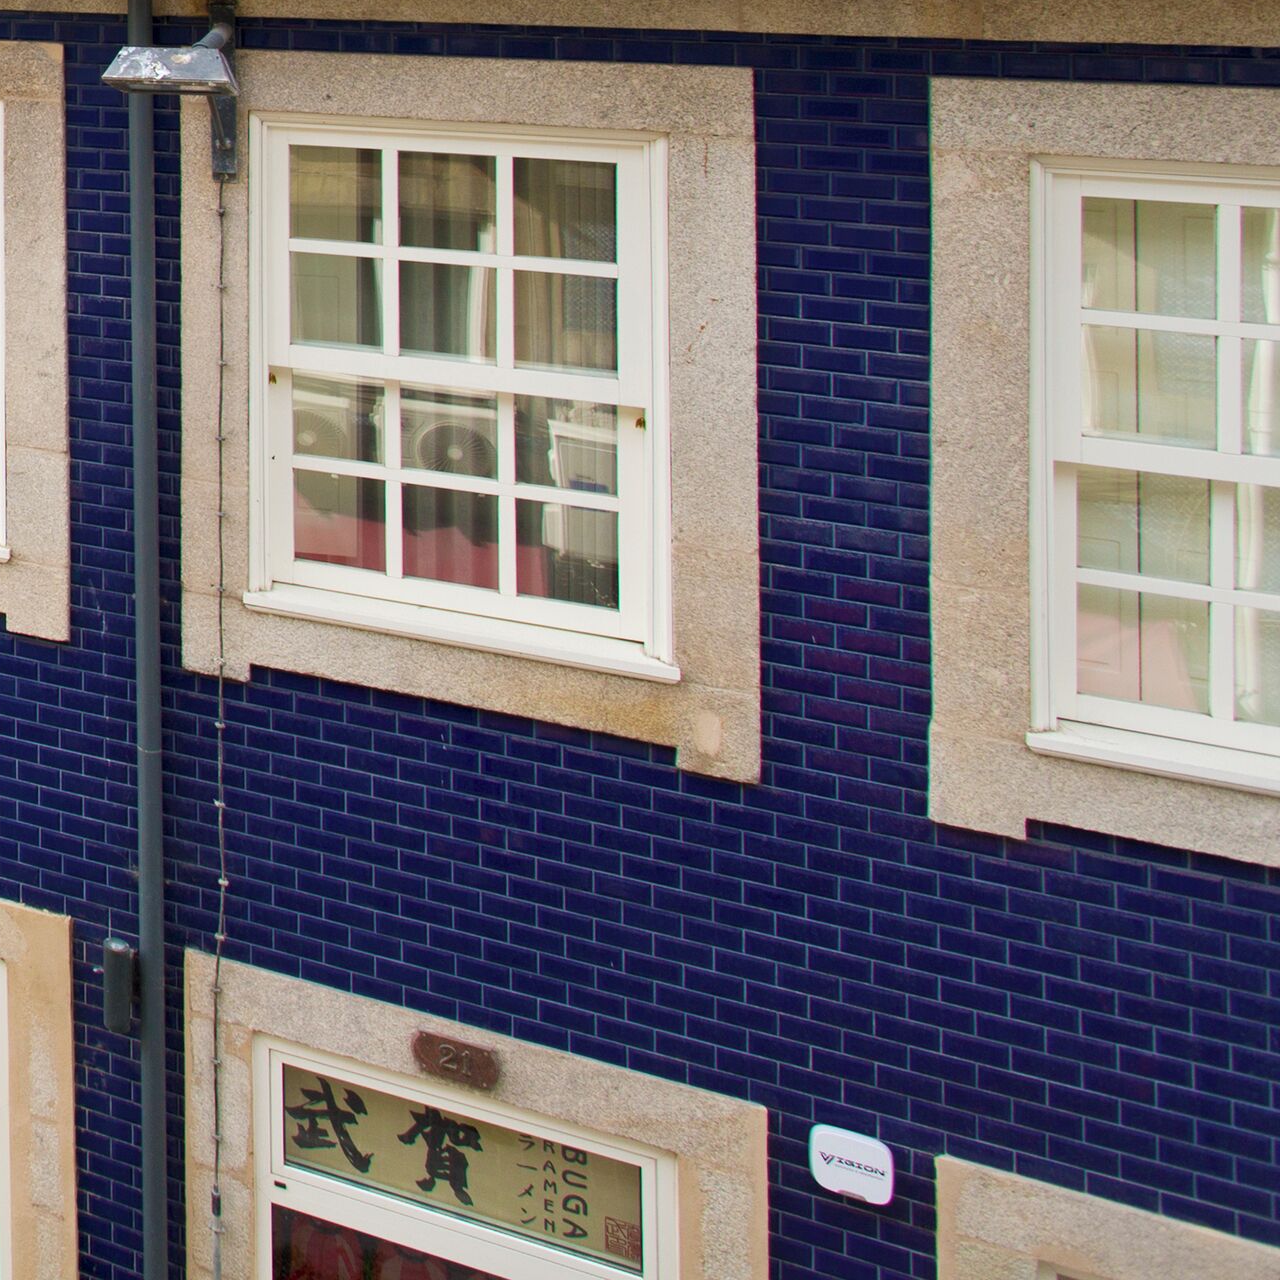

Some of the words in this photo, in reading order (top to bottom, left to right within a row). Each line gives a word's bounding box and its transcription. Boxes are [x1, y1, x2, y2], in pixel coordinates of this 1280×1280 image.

[438, 1043, 472, 1077] 21
[286, 1075, 483, 1207] 武賀
[516, 1134, 538, 1225] ラーメン
[543, 1139, 558, 1233] RAMEN
[561, 1145, 589, 1238] BUGA
